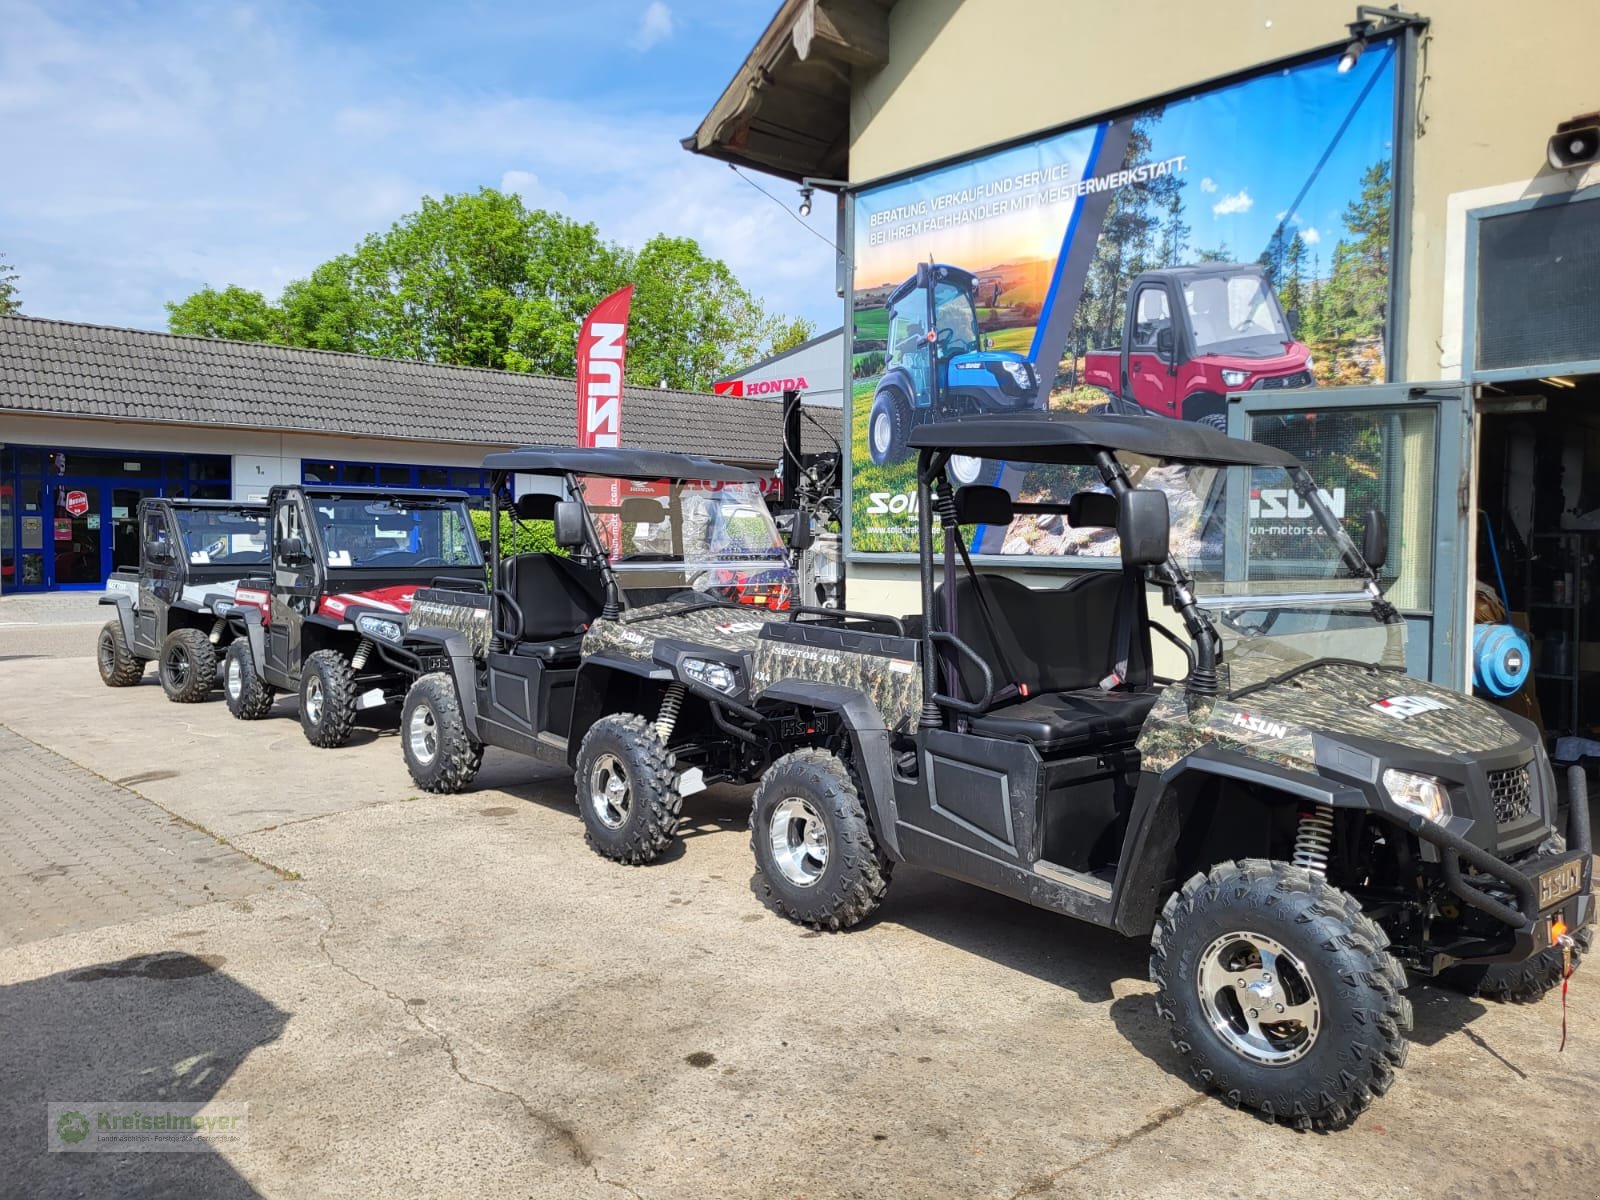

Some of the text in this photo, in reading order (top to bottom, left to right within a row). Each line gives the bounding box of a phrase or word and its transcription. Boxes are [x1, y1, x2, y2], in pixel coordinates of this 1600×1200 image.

[870, 163, 1070, 227] BERATUNG, VERKAUF UND SERVICE
[870, 225, 888, 246] BEI
[887, 220, 922, 243] IHREM
[1012, 195, 1034, 213] MIT
[746, 376, 809, 396] HONDA
[774, 647, 818, 661] SECTOR
